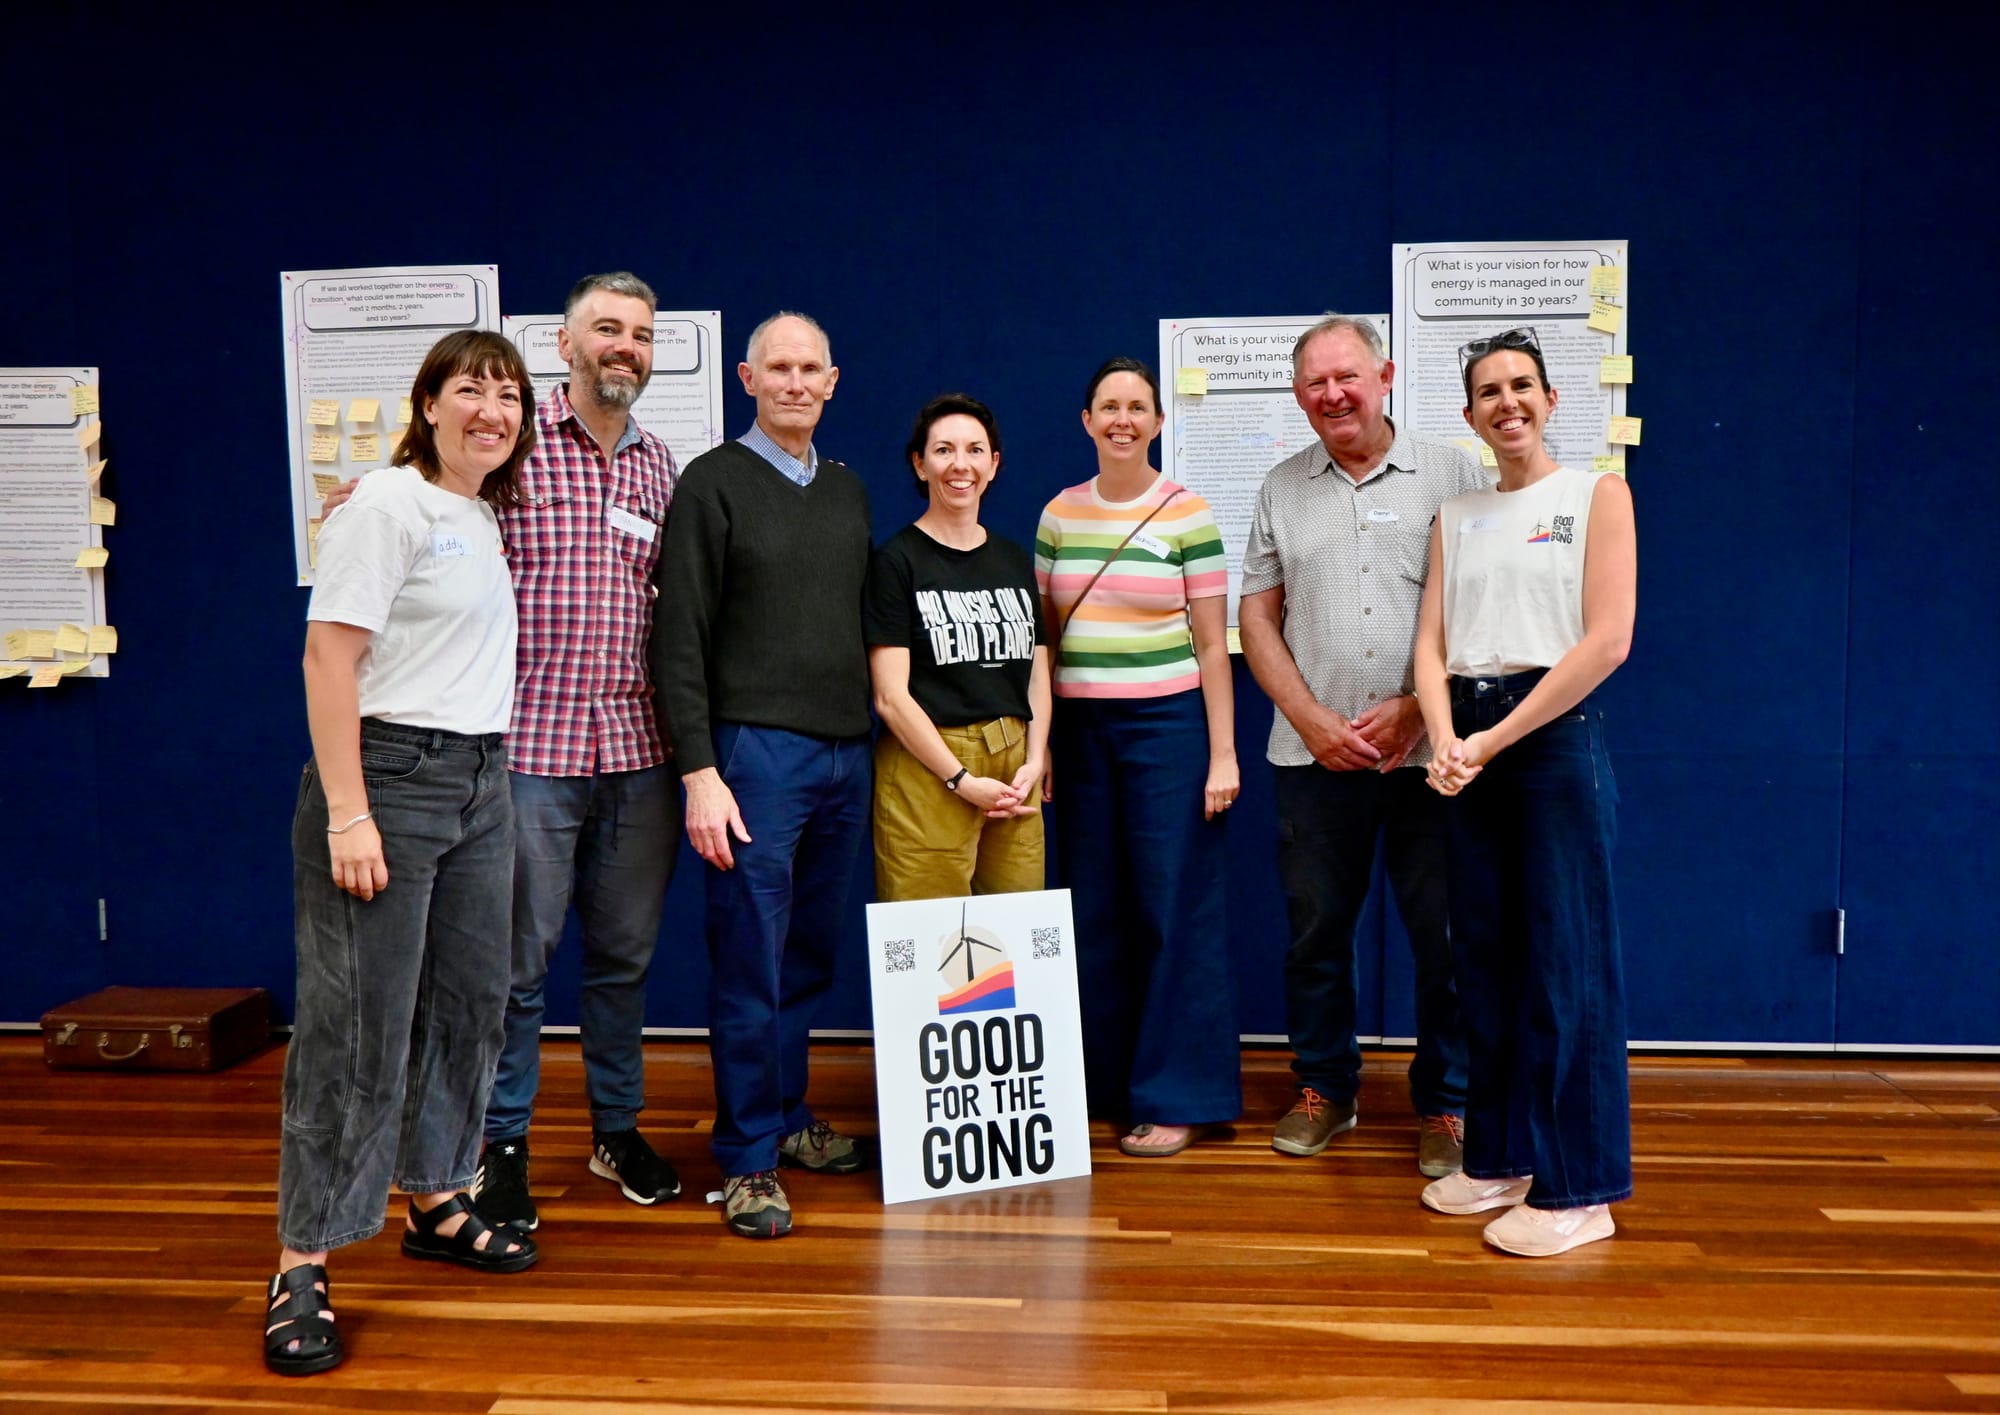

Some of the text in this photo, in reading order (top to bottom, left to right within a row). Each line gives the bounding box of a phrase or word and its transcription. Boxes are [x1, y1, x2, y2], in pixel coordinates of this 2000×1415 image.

[1427, 259, 1589, 272] What is your vision for how
[374, 283, 403, 291] together
[429, 282, 454, 290] energy
[1431, 280, 1474, 290] energy
[1477, 278, 1486, 288] is
[1489, 277, 1547, 290] managed
[1550, 276, 1561, 287] in
[1564, 279, 1585, 287] our
[416, 292, 443, 300] happen
[1434, 294, 1578, 308] community in 30 years?
[389, 313, 411, 322] years?
[654, 328, 676, 336] nergy
[1194, 333, 1299, 347] What is your visio
[1198, 352, 1294, 365] energy is manag
[1272, 369, 1283, 379] in
[1553, 515, 1574, 526] GOOD
[1551, 531, 1573, 544] GONG
[916, 590, 948, 629] NO
[942, 590, 1001, 624] MUSIC
[994, 588, 1026, 622] ON
[930, 622, 1035, 666] DEAD PLANE
[919, 1013, 1045, 1084] GOOD
[926, 1075, 1046, 1123] FOR THE
[922, 1112, 1055, 1190] GONG
